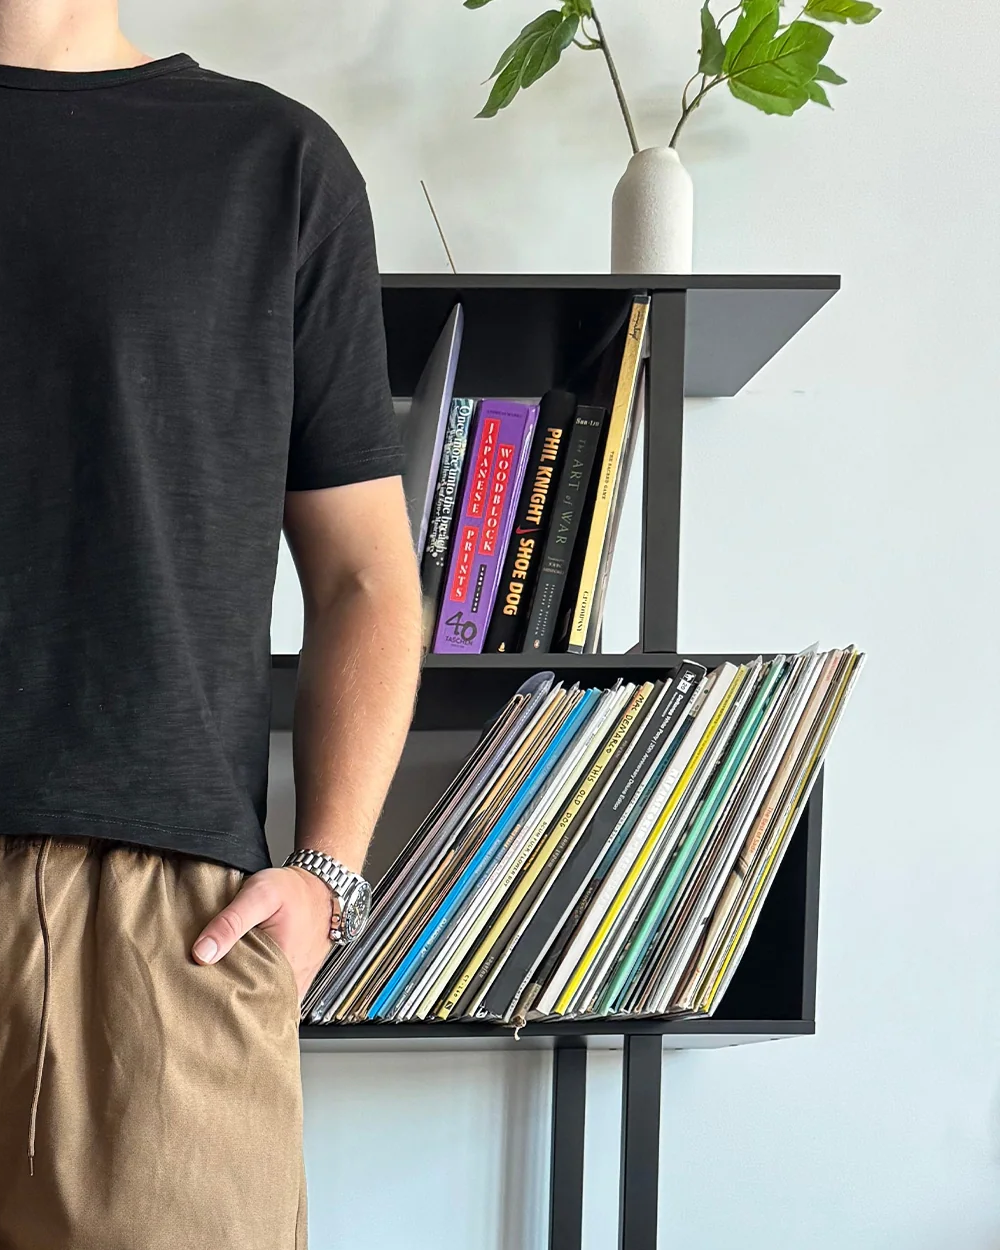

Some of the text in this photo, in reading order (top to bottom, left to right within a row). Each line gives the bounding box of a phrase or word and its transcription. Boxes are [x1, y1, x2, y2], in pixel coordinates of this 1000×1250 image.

[454, 405, 472, 436] Once
[472, 423, 495, 514] JAPANESE
[523, 425, 563, 525] PHIL KNIGHT
[567, 458, 584, 491] ART
[445, 468, 459, 495] unto
[442, 496, 454, 514] the
[484, 448, 512, 551] WOODBLOCK
[562, 494, 574, 506] of
[554, 509, 573, 545] WAR
[456, 530, 475, 597] PRINTS
[501, 536, 535, 617] SHOE DOG
[445, 611, 477, 641] 40
[629, 693, 645, 712] MAC
[659, 714, 671, 729] White
[603, 713, 634, 754] DEMARCO
[651, 727, 663, 741] Pony
[586, 763, 602, 783] THIS
[629, 751, 649, 779] Anniversary
[572, 788, 587, 805] OLD
[611, 794, 624, 811] Edition
[557, 811, 572, 829] DOG
[764, 806, 773, 817] The
[758, 817, 768, 831] Best
[748, 838, 759, 853] Sade
